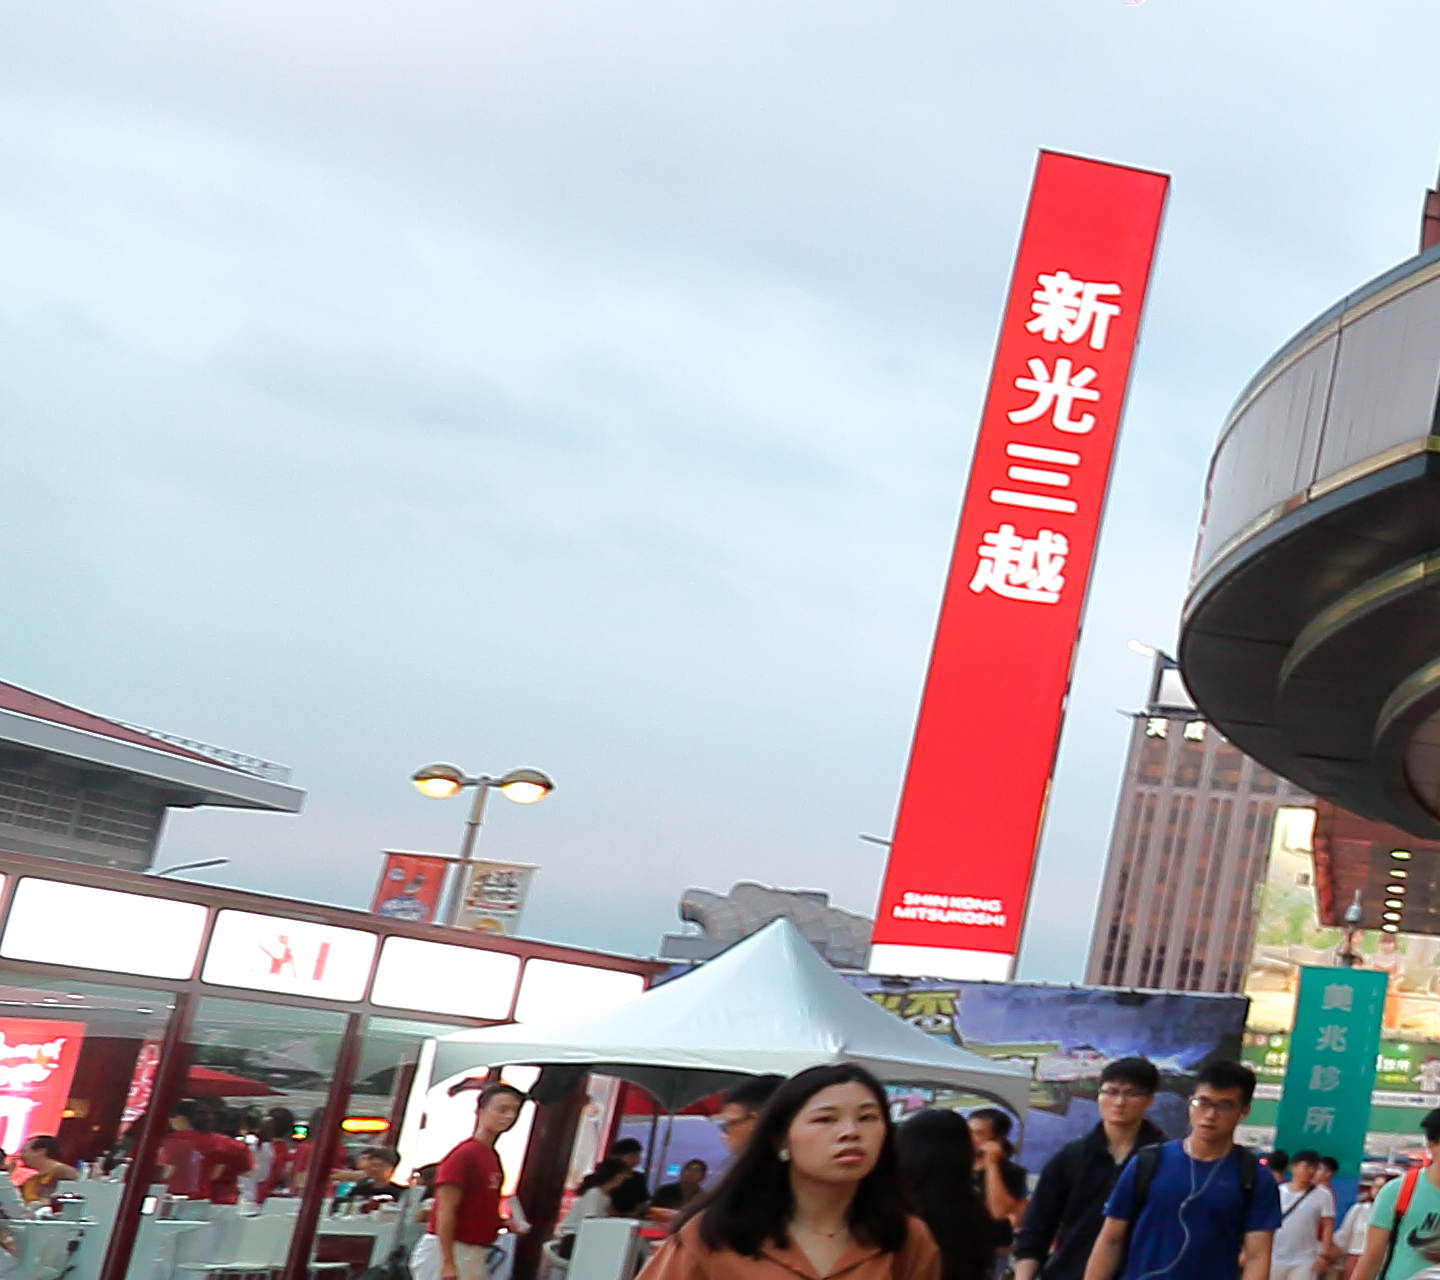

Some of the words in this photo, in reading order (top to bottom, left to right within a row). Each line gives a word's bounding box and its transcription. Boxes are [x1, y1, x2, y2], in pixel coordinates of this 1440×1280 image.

[968, 269, 1123, 605] 新光三越
[892, 905, 1008, 928] MITSUKOSHI
[903, 891, 949, 909] SHIN
[949, 895, 1003, 914] KONG
[1303, 983, 1354, 1134] 美兆診所
